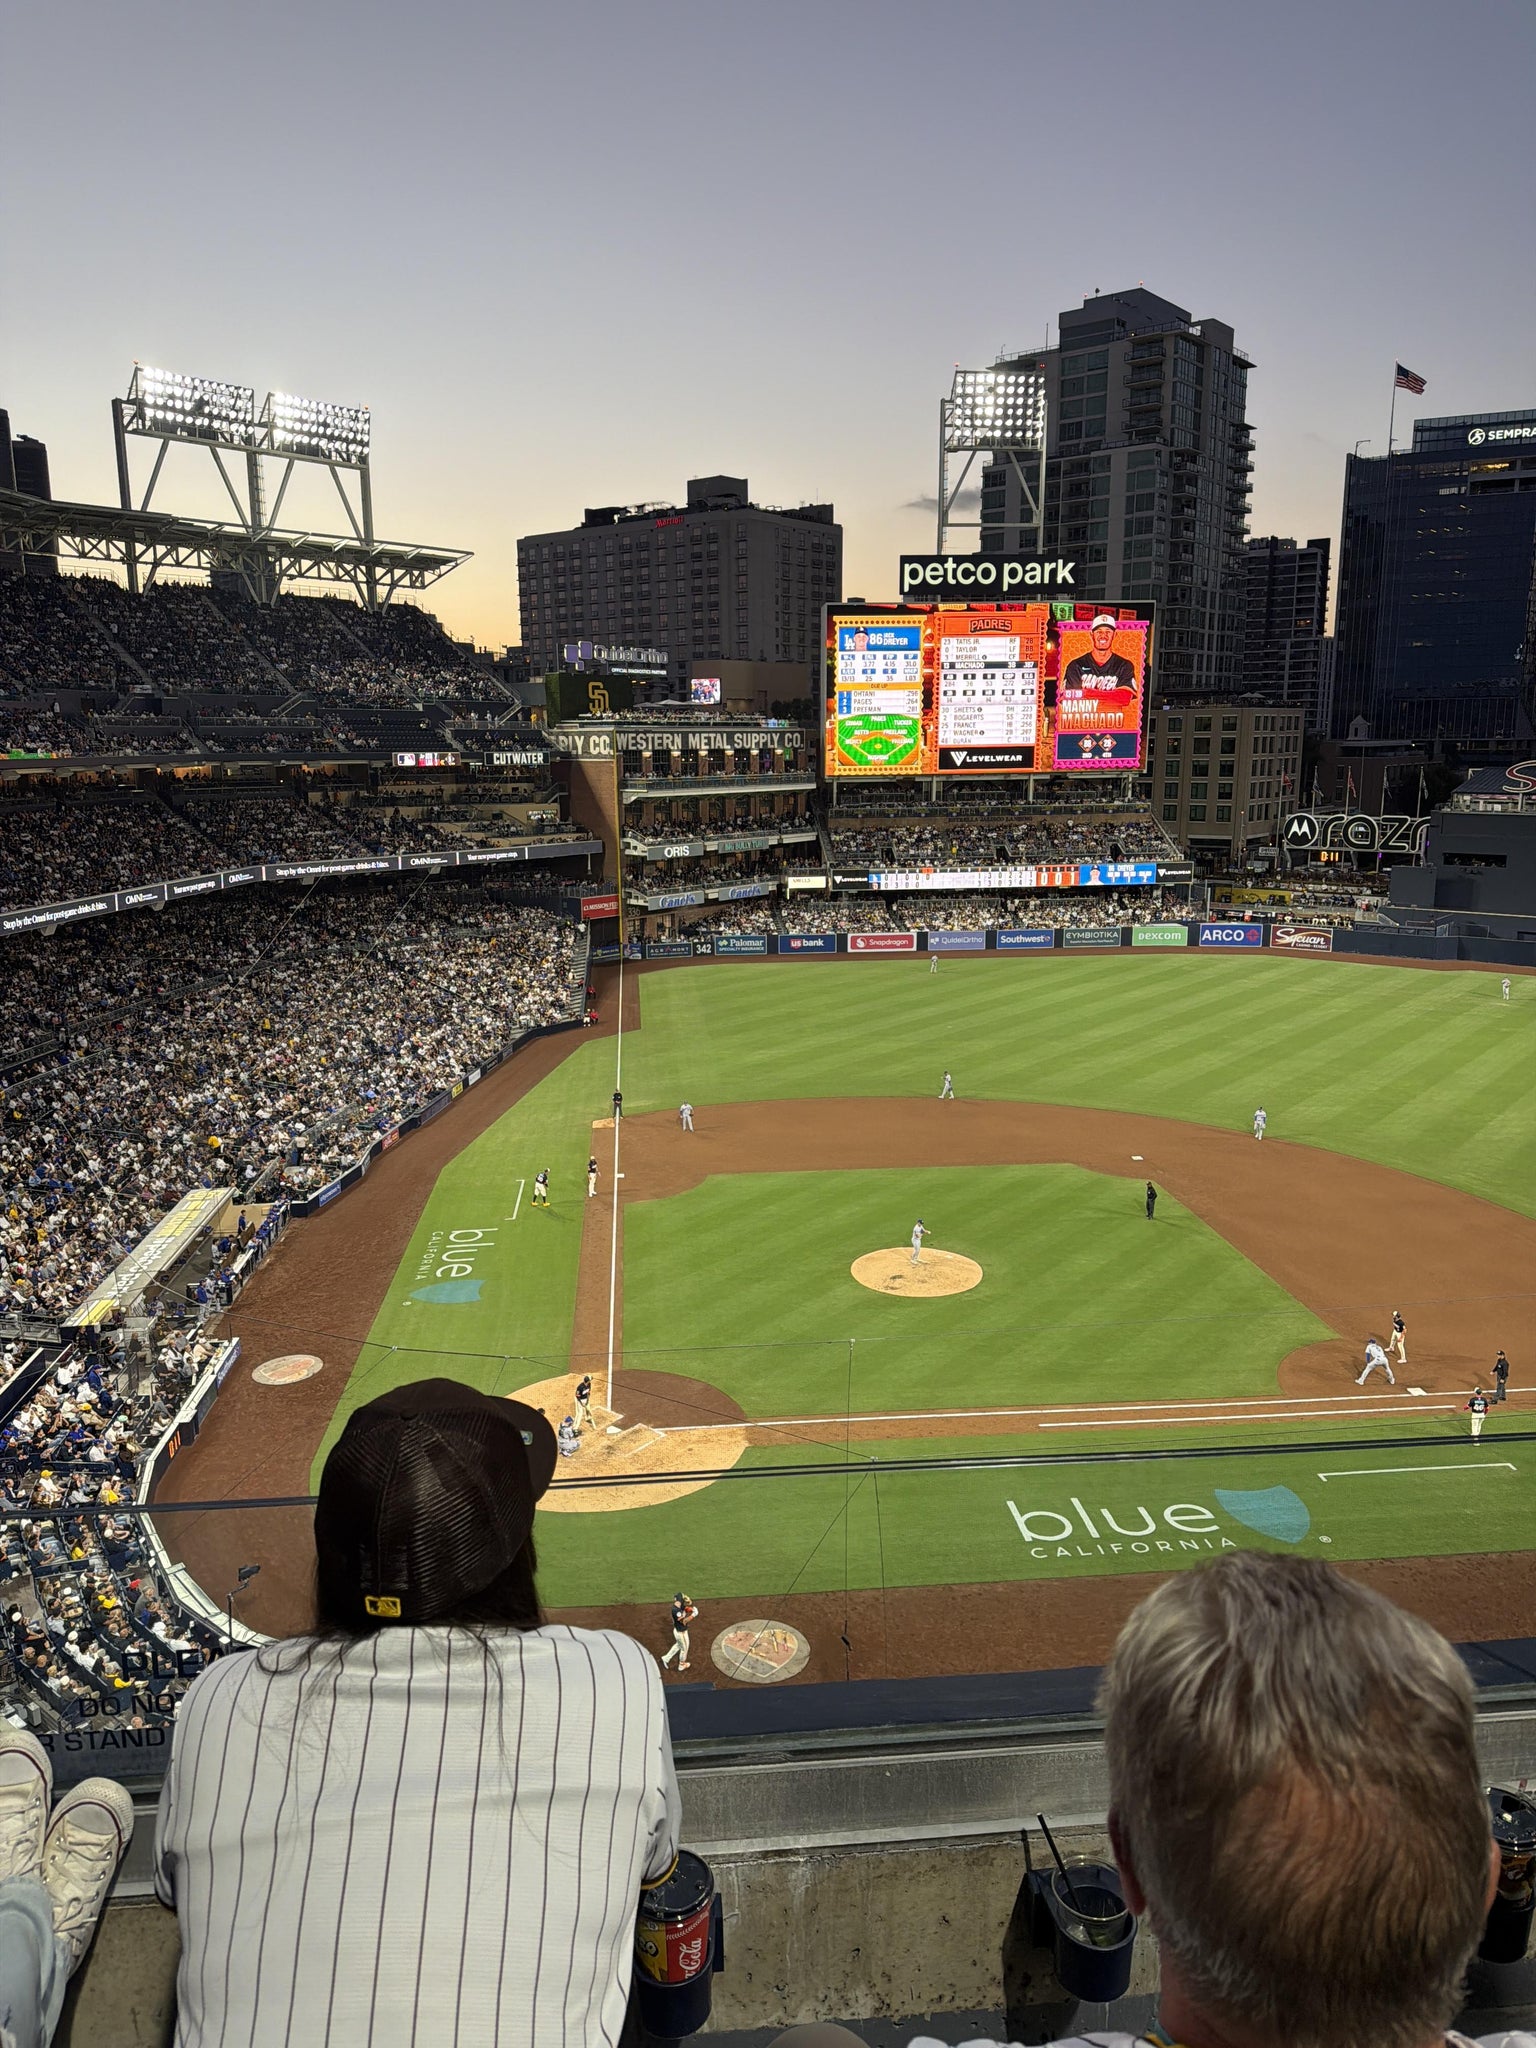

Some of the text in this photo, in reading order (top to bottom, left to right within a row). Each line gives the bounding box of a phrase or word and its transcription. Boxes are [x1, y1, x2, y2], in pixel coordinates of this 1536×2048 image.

[656, 516, 685, 528] Marriott
[903, 557, 1076, 592] petco park
[970, 618, 1012, 633] PADRES
[869, 633, 883, 645] 86
[883, 637, 908, 646] DREYER
[1062, 699, 1099, 713] MANNY
[954, 713, 984, 721] BOGAERTS
[1061, 712, 1124, 729] MACHADO
[590, 735, 613, 755] CO.
[616, 732, 804, 750] WESTERN METAL SUPPLY CO.
[493, 752, 544, 765] CUTWATER
[966, 754, 1023, 763] LEVELWEAR
[1321, 814, 1431, 852] razr
[664, 845, 690, 858] ORIS
[1321, 852, 1339, 862] 0:11
[410, 857, 430, 866] OMNI
[276, 868, 290, 877] Stop
[289, 867, 296, 876] by
[296, 866, 306, 874] the
[306, 865, 321, 874] Omni
[321, 864, 329, 872] for
[356, 862, 371, 870] drinks
[1041, 872, 1048, 884] 0
[1055, 872, 1062, 884] 0
[729, 885, 762, 899] Canel's
[125, 893, 143, 905] OMNI
[659, 893, 696, 908] Canel's
[589, 902, 608, 910] MISSION
[3, 920, 16, 930] Stop
[15, 917, 23, 929] by
[23, 916, 32, 926] the
[32, 912, 46, 924] Omni
[46, 911, 54, 921] for
[77, 904, 91, 914] drinks
[942, 937, 983, 945] QuidelOrtho
[1001, 935, 1045, 944] Southwest
[1066, 931, 1119, 939] CYMBIOTIKA
[1202, 929, 1245, 942] ARCO
[1275, 928, 1326, 947] Sycuan
[730, 938, 764, 947] Palomar
[791, 938, 824, 947] us bank
[869, 938, 909, 946] Snapdragon
[696, 944, 712, 954] 342
[415, 1231, 444, 1280] CALIFORNIA
[436, 1228, 498, 1277] blue
[1006, 1497, 1220, 1542] blue
[1031, 1537, 1236, 1559] CALIFORNIA
[79, 1693, 180, 1718] DO NO
[37, 1727, 166, 1753] R STAND
